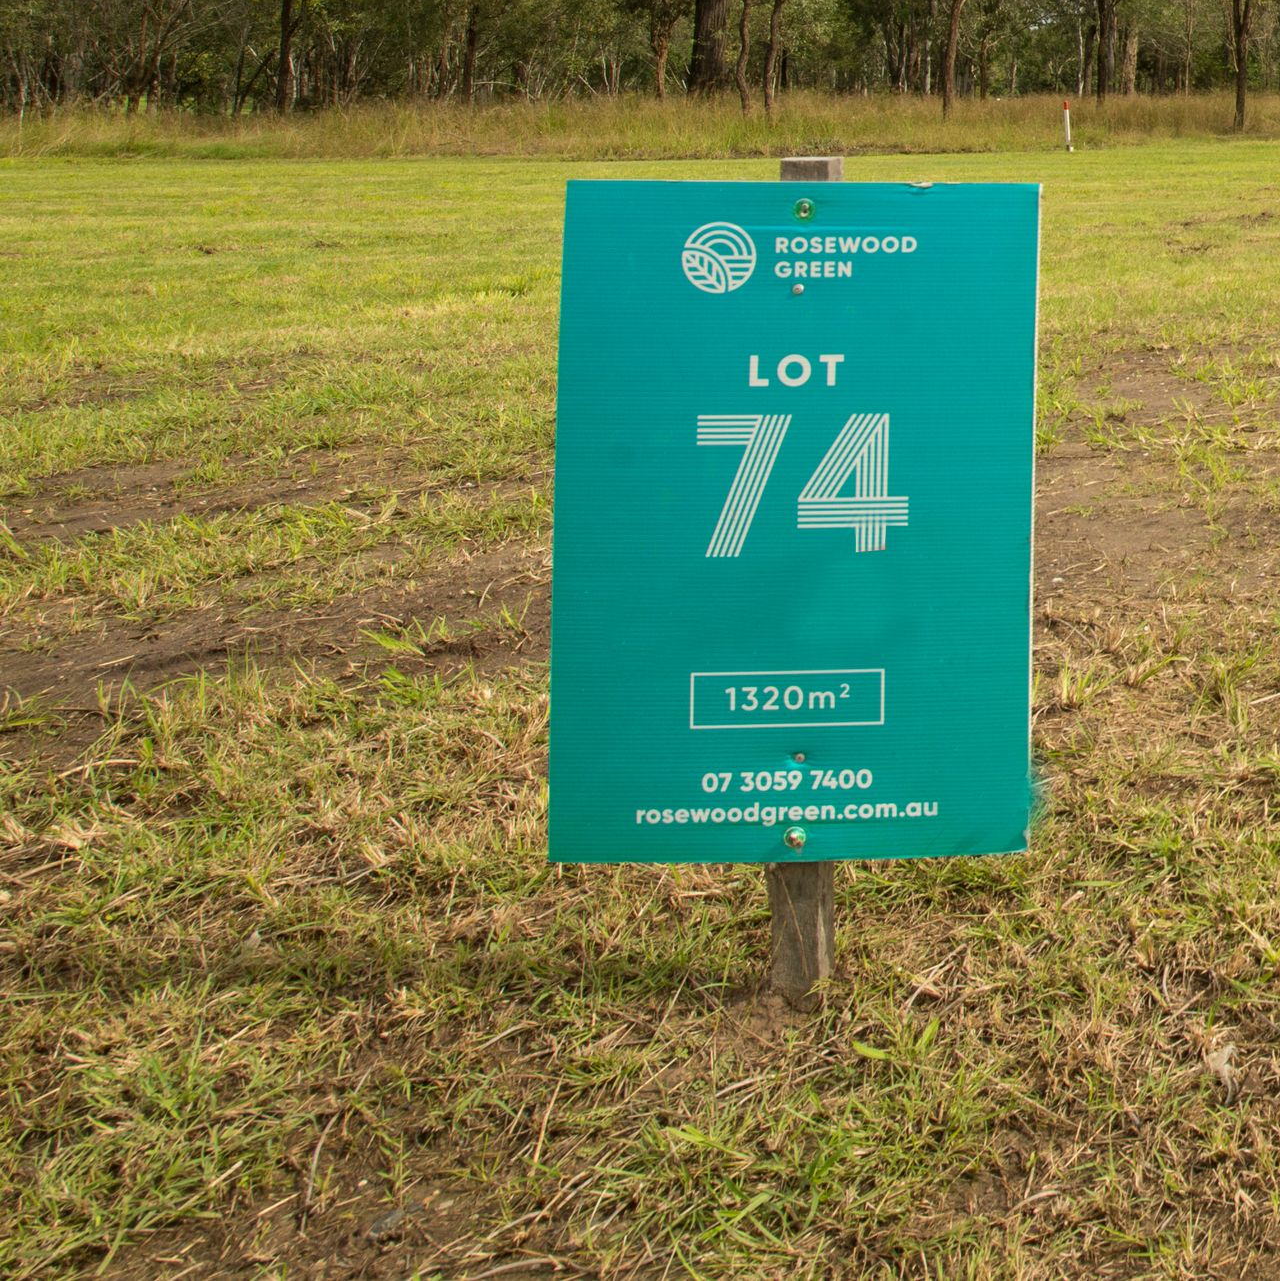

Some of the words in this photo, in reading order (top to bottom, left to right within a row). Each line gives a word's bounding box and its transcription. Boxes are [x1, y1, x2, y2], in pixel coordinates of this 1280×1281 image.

[775, 236, 917, 254] ROSEWOOD
[774, 261, 852, 278] GREEN
[749, 354, 845, 387] LOT
[697, 413, 909, 557] 74
[701, 773, 731, 793] 07
[740, 771, 803, 792] 3059
[810, 769, 873, 790] 7400
[636, 800, 938, 825] rosewoodgreen.com.au
